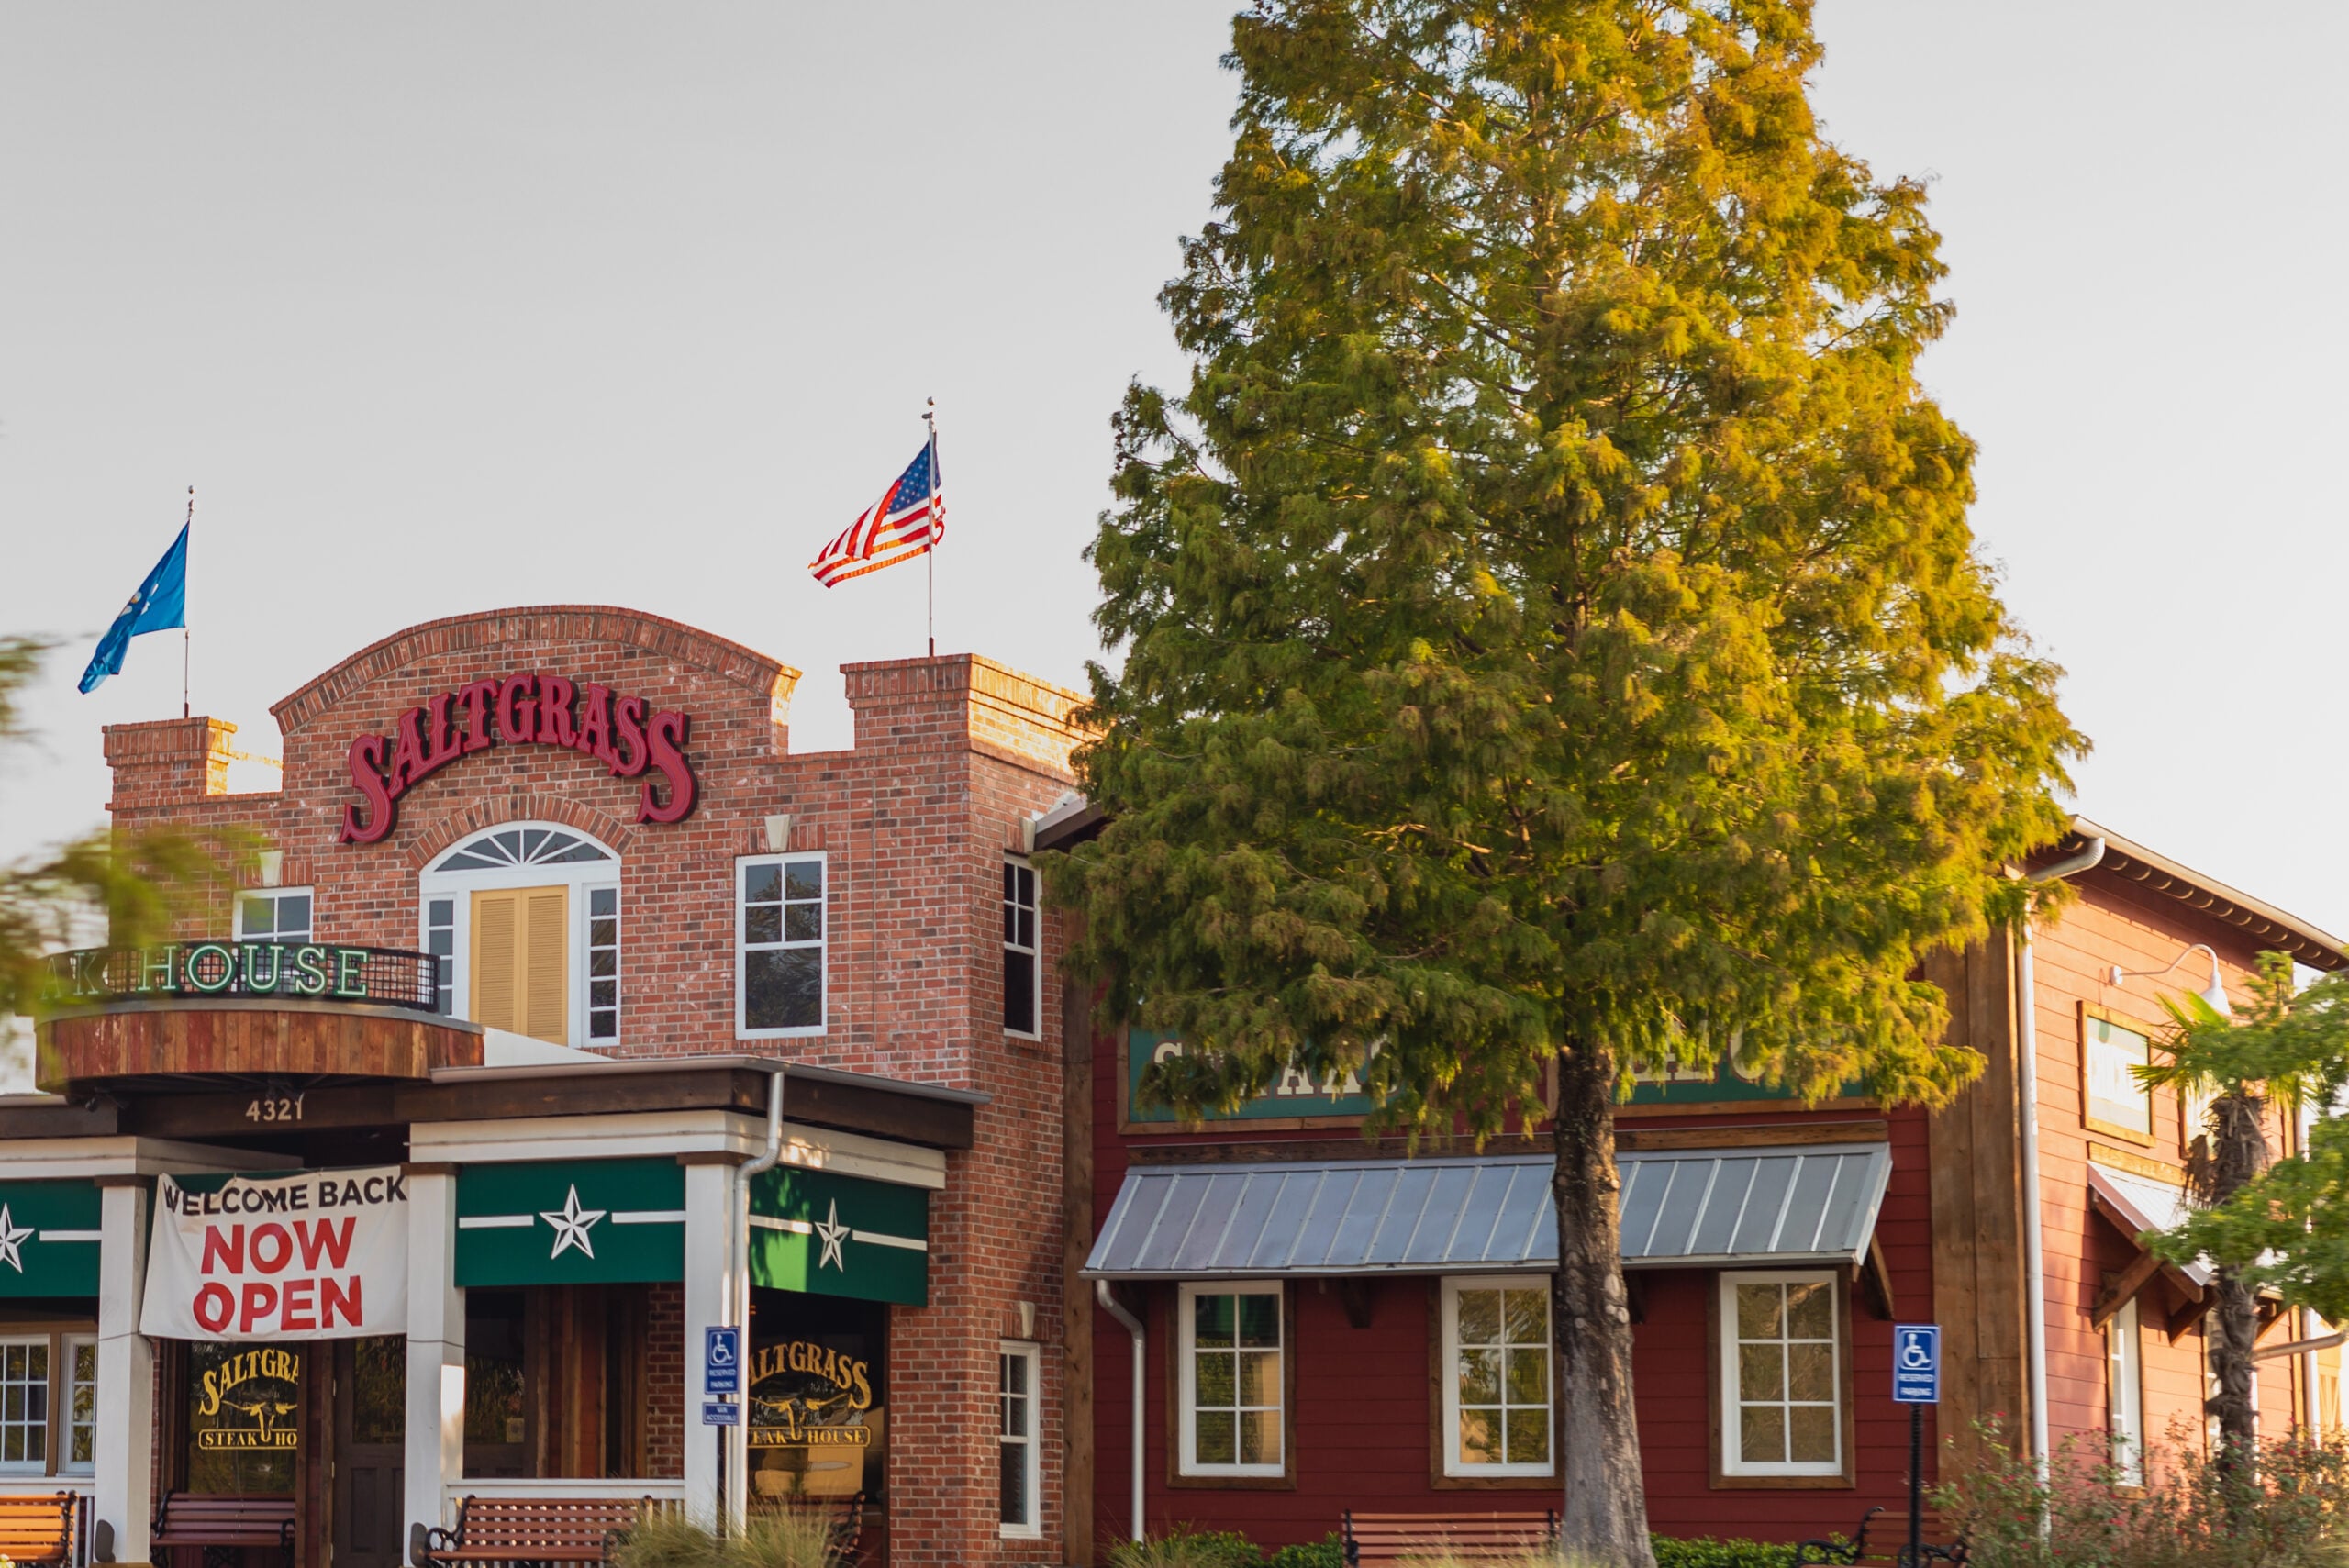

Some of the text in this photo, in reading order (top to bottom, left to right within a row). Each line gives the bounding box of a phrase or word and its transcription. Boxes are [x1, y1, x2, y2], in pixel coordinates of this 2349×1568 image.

[339, 673, 697, 843] SALTGRASS
[137, 942, 369, 998] HOUSE
[245, 1094, 305, 1121] 4321
[163, 1173, 408, 1217] WELCOME BACK
[200, 1216, 357, 1274] NOW
[193, 1275, 363, 1333] OPEN
[206, 1432, 257, 1446] STEAK
[807, 1429, 863, 1444] HOUSE
